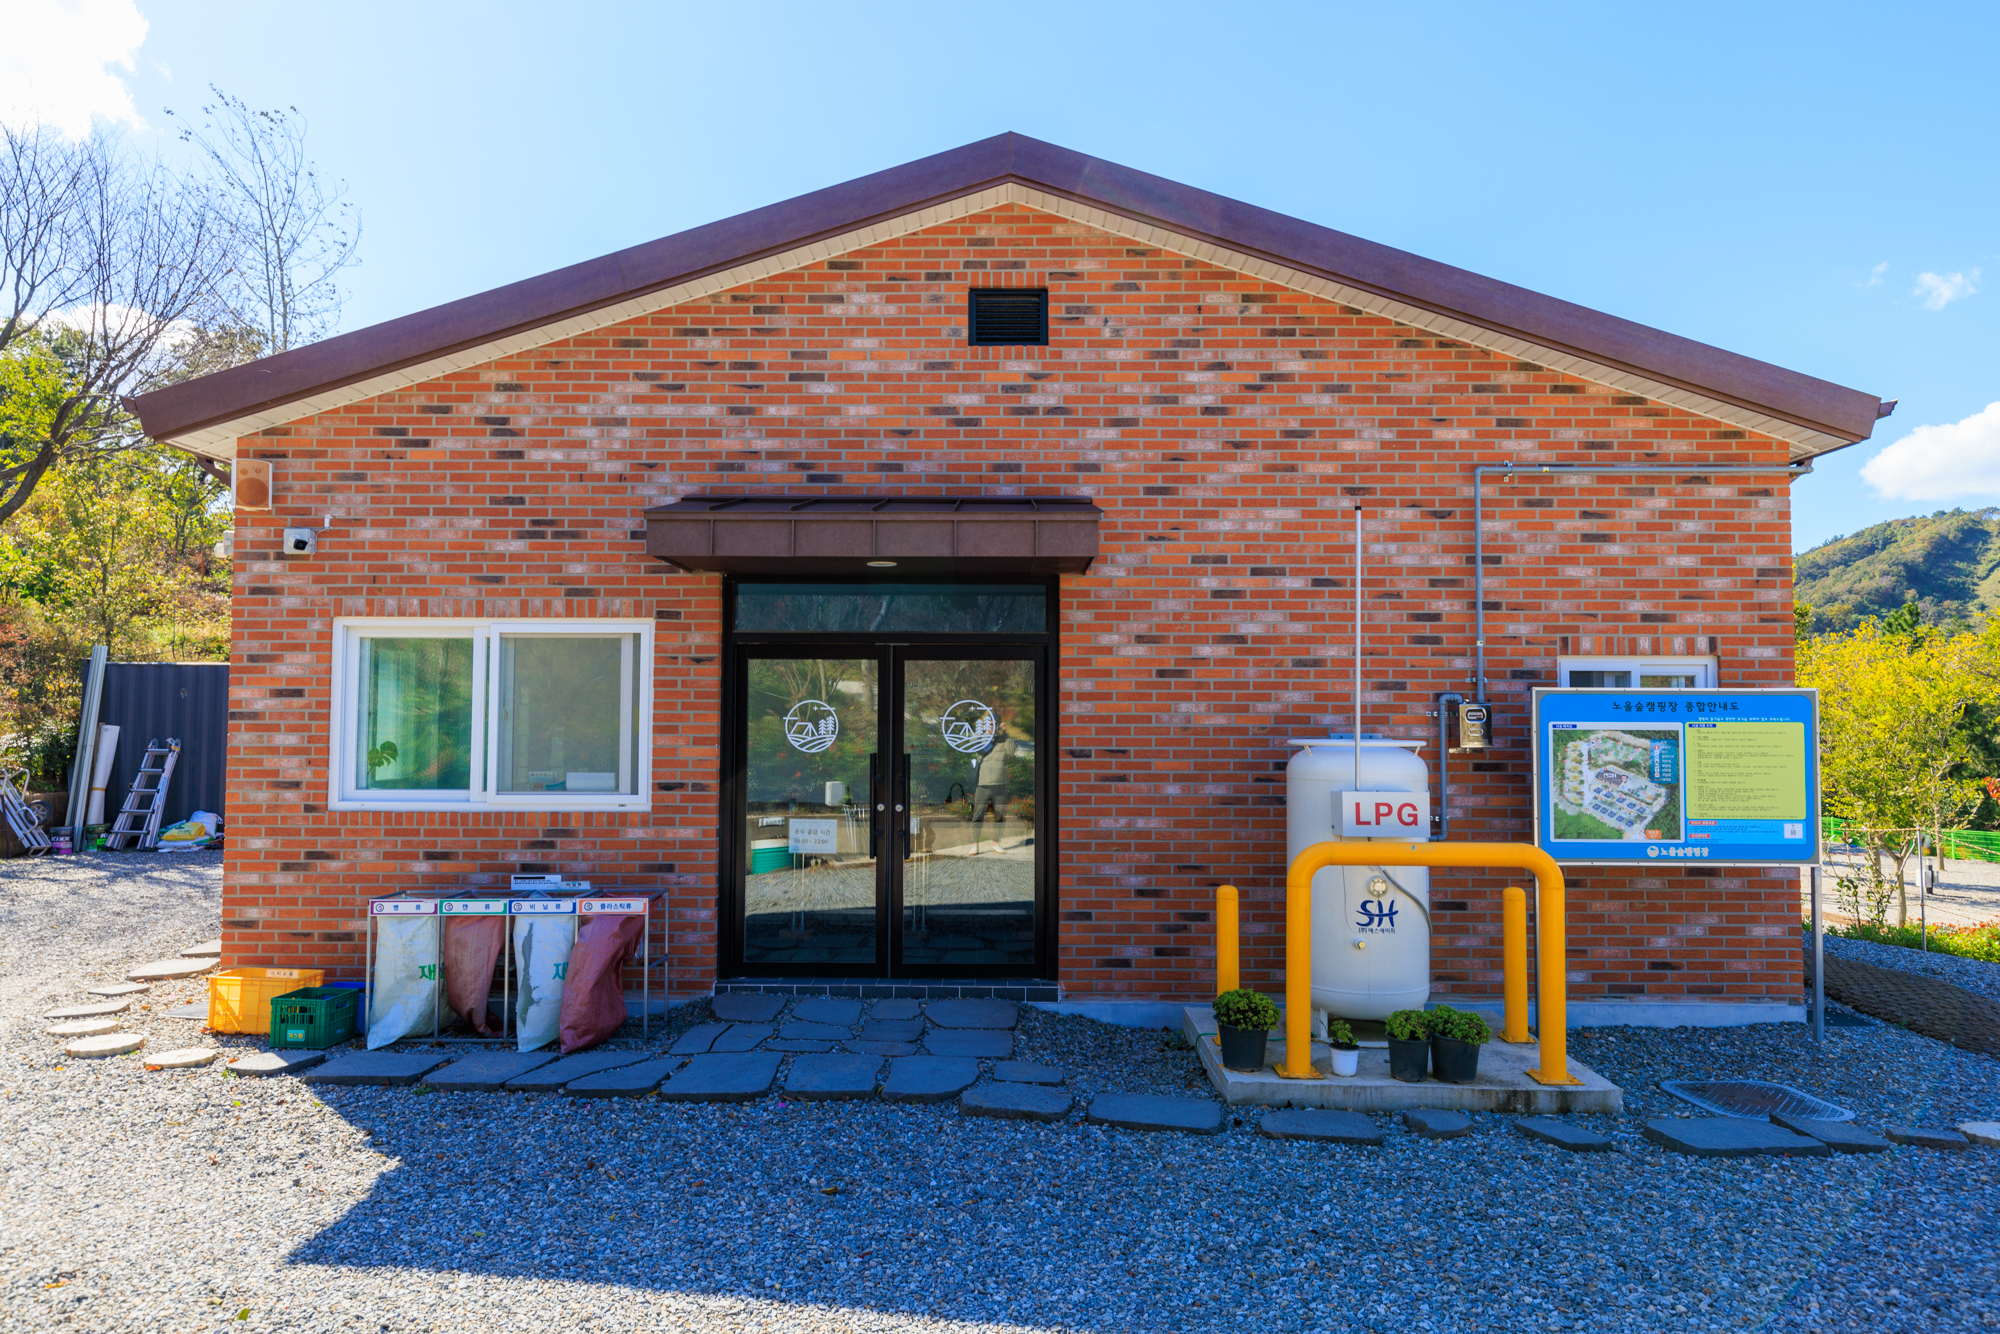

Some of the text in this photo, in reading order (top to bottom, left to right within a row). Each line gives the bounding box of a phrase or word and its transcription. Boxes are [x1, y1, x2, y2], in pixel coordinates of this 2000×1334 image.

[1612, 701, 1740, 713] 노을숲캠핑장 종합안내도
[1355, 802, 1418, 827] LPG
[1356, 899, 1399, 928] SH
